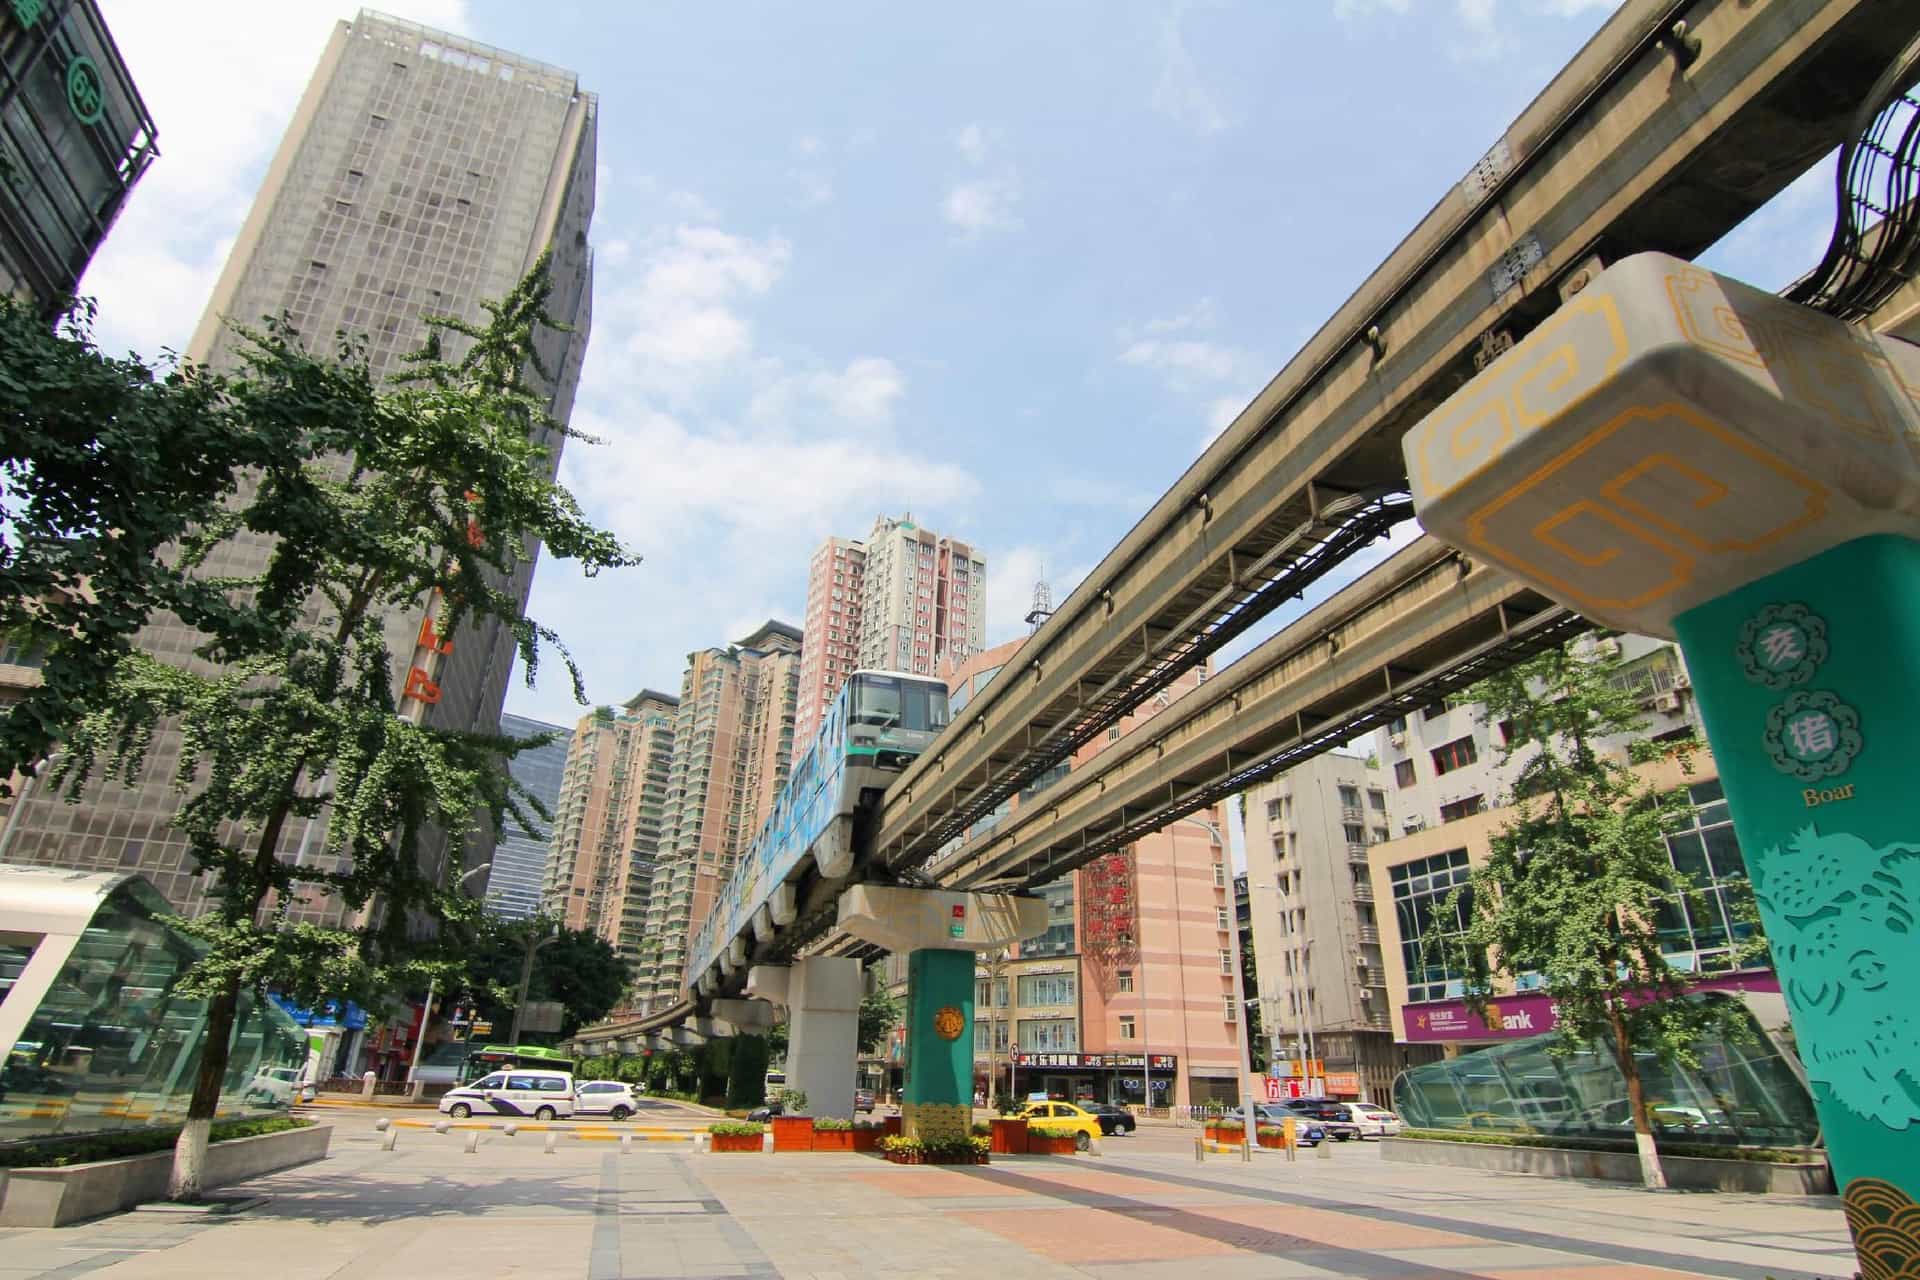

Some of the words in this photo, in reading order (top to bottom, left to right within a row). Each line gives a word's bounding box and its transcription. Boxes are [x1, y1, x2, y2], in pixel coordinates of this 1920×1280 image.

[1760, 627, 1801, 666] 亥
[1789, 713, 1834, 756] 猪
[1802, 784, 1855, 808] Boar
